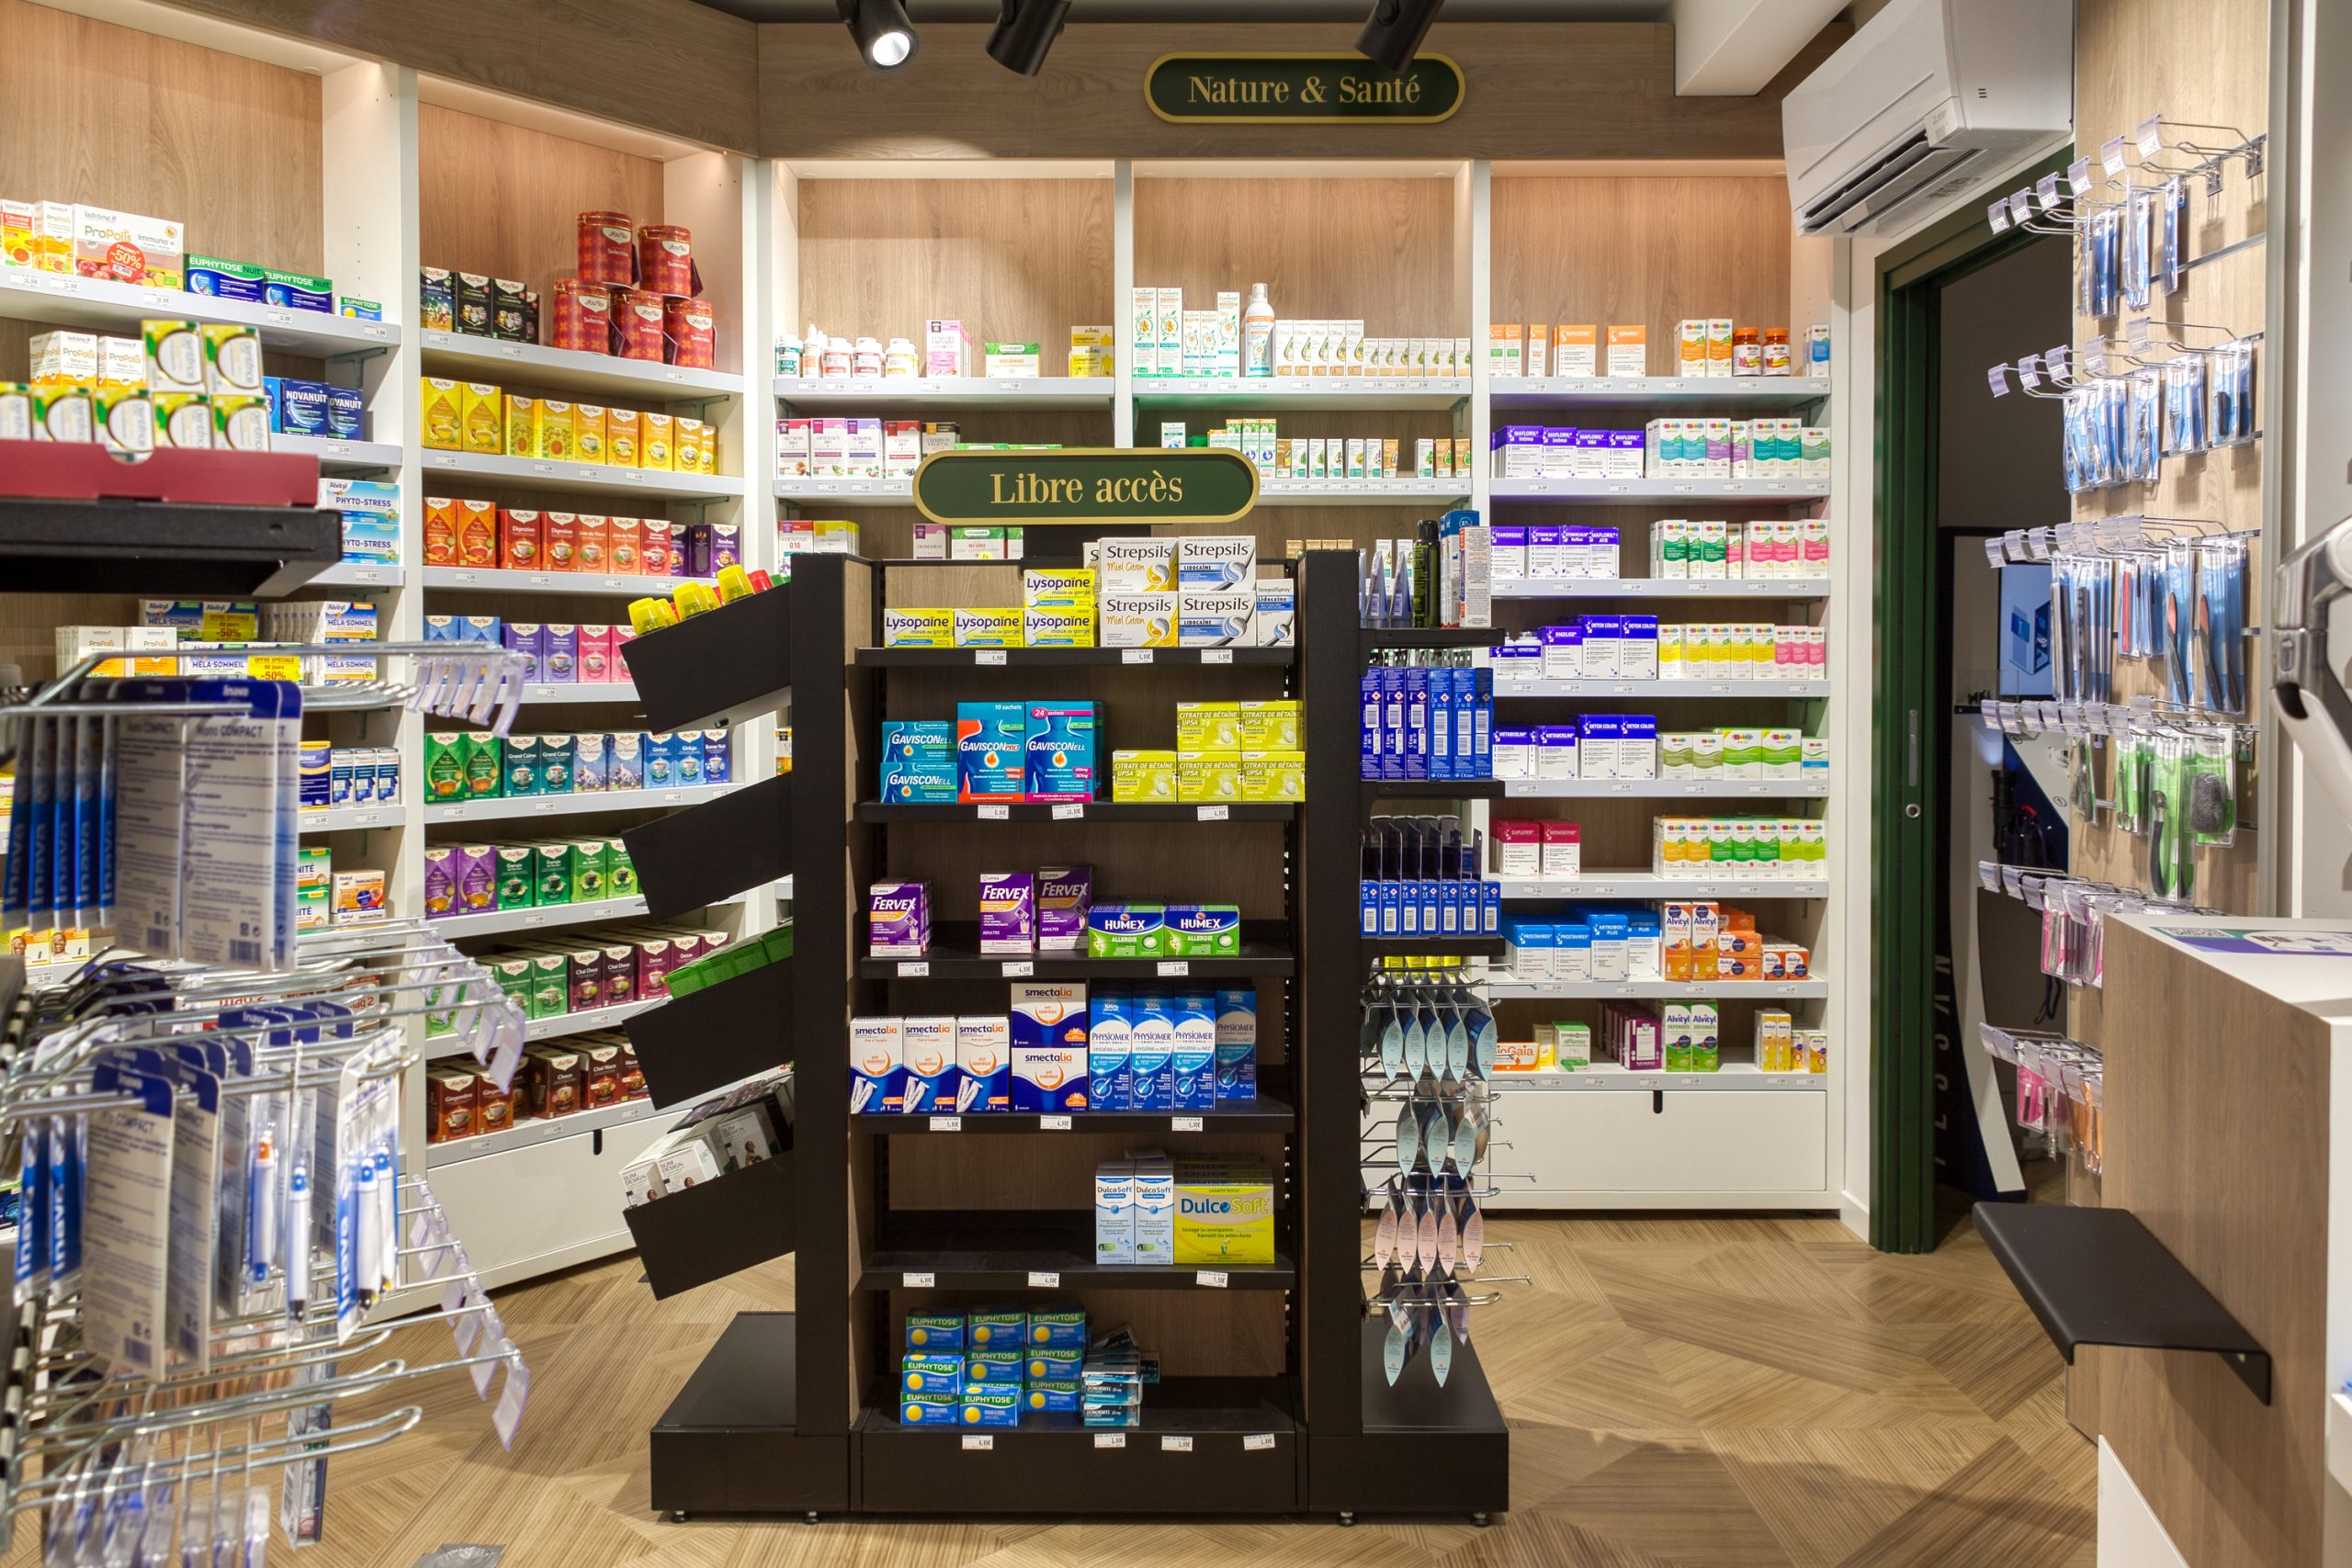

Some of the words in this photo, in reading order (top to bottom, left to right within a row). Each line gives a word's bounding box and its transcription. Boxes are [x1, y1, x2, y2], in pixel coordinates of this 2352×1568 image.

[1188, 76, 1289, 103] Nature
[1300, 77, 1328, 105] &
[1340, 74, 1421, 105] Santé
[85, 225, 131, 243] ProPolis
[110, 251, 141, 269] -50%
[189, 257, 242, 272] EUPHYTOSE
[243, 265, 260, 275] Nuit
[264, 271, 312, 286] EUPHYTOSE
[313, 279, 329, 288] Nuit
[344, 298, 379, 309] EUPHYTOSE
[63, 348, 96, 359] ProPolis
[109, 353, 141, 364] ProPolis
[286, 389, 327, 403] NOVANUIT
[989, 472, 1083, 504] Libre
[1095, 469, 1183, 503] accès
[336, 497, 391, 507] PHYTO-STRESS
[513, 525, 535, 534] Digestion
[1107, 546, 1170, 561] Strepsils
[1184, 543, 1249, 558] Strepsils
[1106, 562, 1125, 570] Miel
[1125, 562, 1145, 572] Citron
[1027, 577, 1091, 591] Lysopaïne
[1107, 599, 1171, 614] Strepsils
[1184, 598, 1249, 614] Strepsils
[886, 616, 949, 629] Lysopaïne
[956, 616, 1019, 629] Lysopaïne
[1026, 616, 1089, 629] Lysopaïne
[1106, 615, 1124, 625] Miel
[1125, 615, 1145, 626] Citron
[216, 628, 242, 638] -50%
[261, 671, 286, 681] -50%
[983, 885, 1029, 901] FERVEX
[1042, 882, 1088, 897] FERVEX
[873, 897, 916, 910] FERVEX
[1104, 920, 1146, 930] HUMEX
[1181, 919, 1220, 929] HUMEX
[1025, 987, 1072, 997] smectalia
[1667, 1014, 1690, 1023] Alvityl
[1693, 1014, 1716, 1023] Alvityl
[855, 1026, 897, 1034] smectalia
[906, 1025, 950, 1033] smectalia
[959, 1025, 1004, 1033] smectalia
[1025, 1053, 1072, 1063] smectalia
[662, 1161, 684, 1173] DESIGN
[1181, 1198, 1269, 1214] DulcoSoft
[975, 1314, 1021, 1323] EUPHYTOSE
[1035, 1314, 1080, 1322] EUPHYTOSE
[1031, 1349, 1076, 1358] EUPHYTOSE
[908, 1362, 953, 1371] EUPHYTOSE
